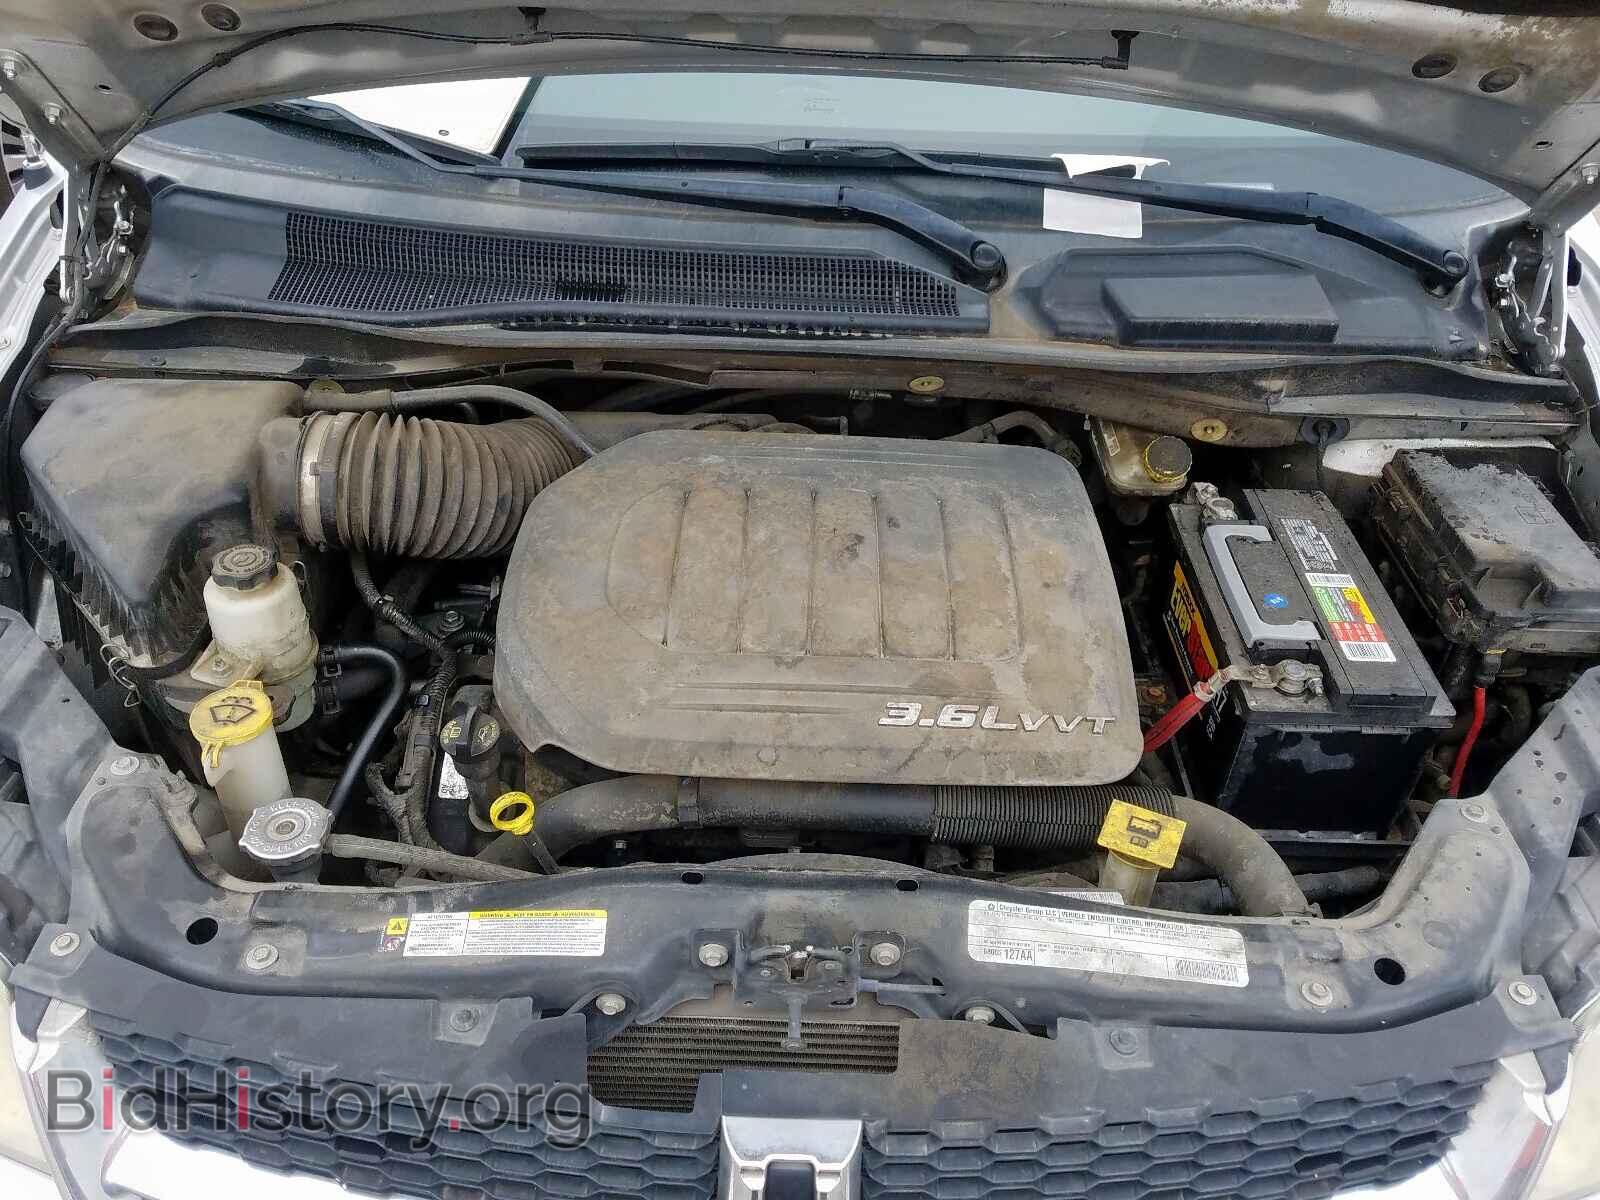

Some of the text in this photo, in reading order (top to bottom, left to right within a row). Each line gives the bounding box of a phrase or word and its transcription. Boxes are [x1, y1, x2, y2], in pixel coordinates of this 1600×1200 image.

[878, 702, 1116, 736] 3.6L VVT
[1003, 948, 1034, 962] 127AA
